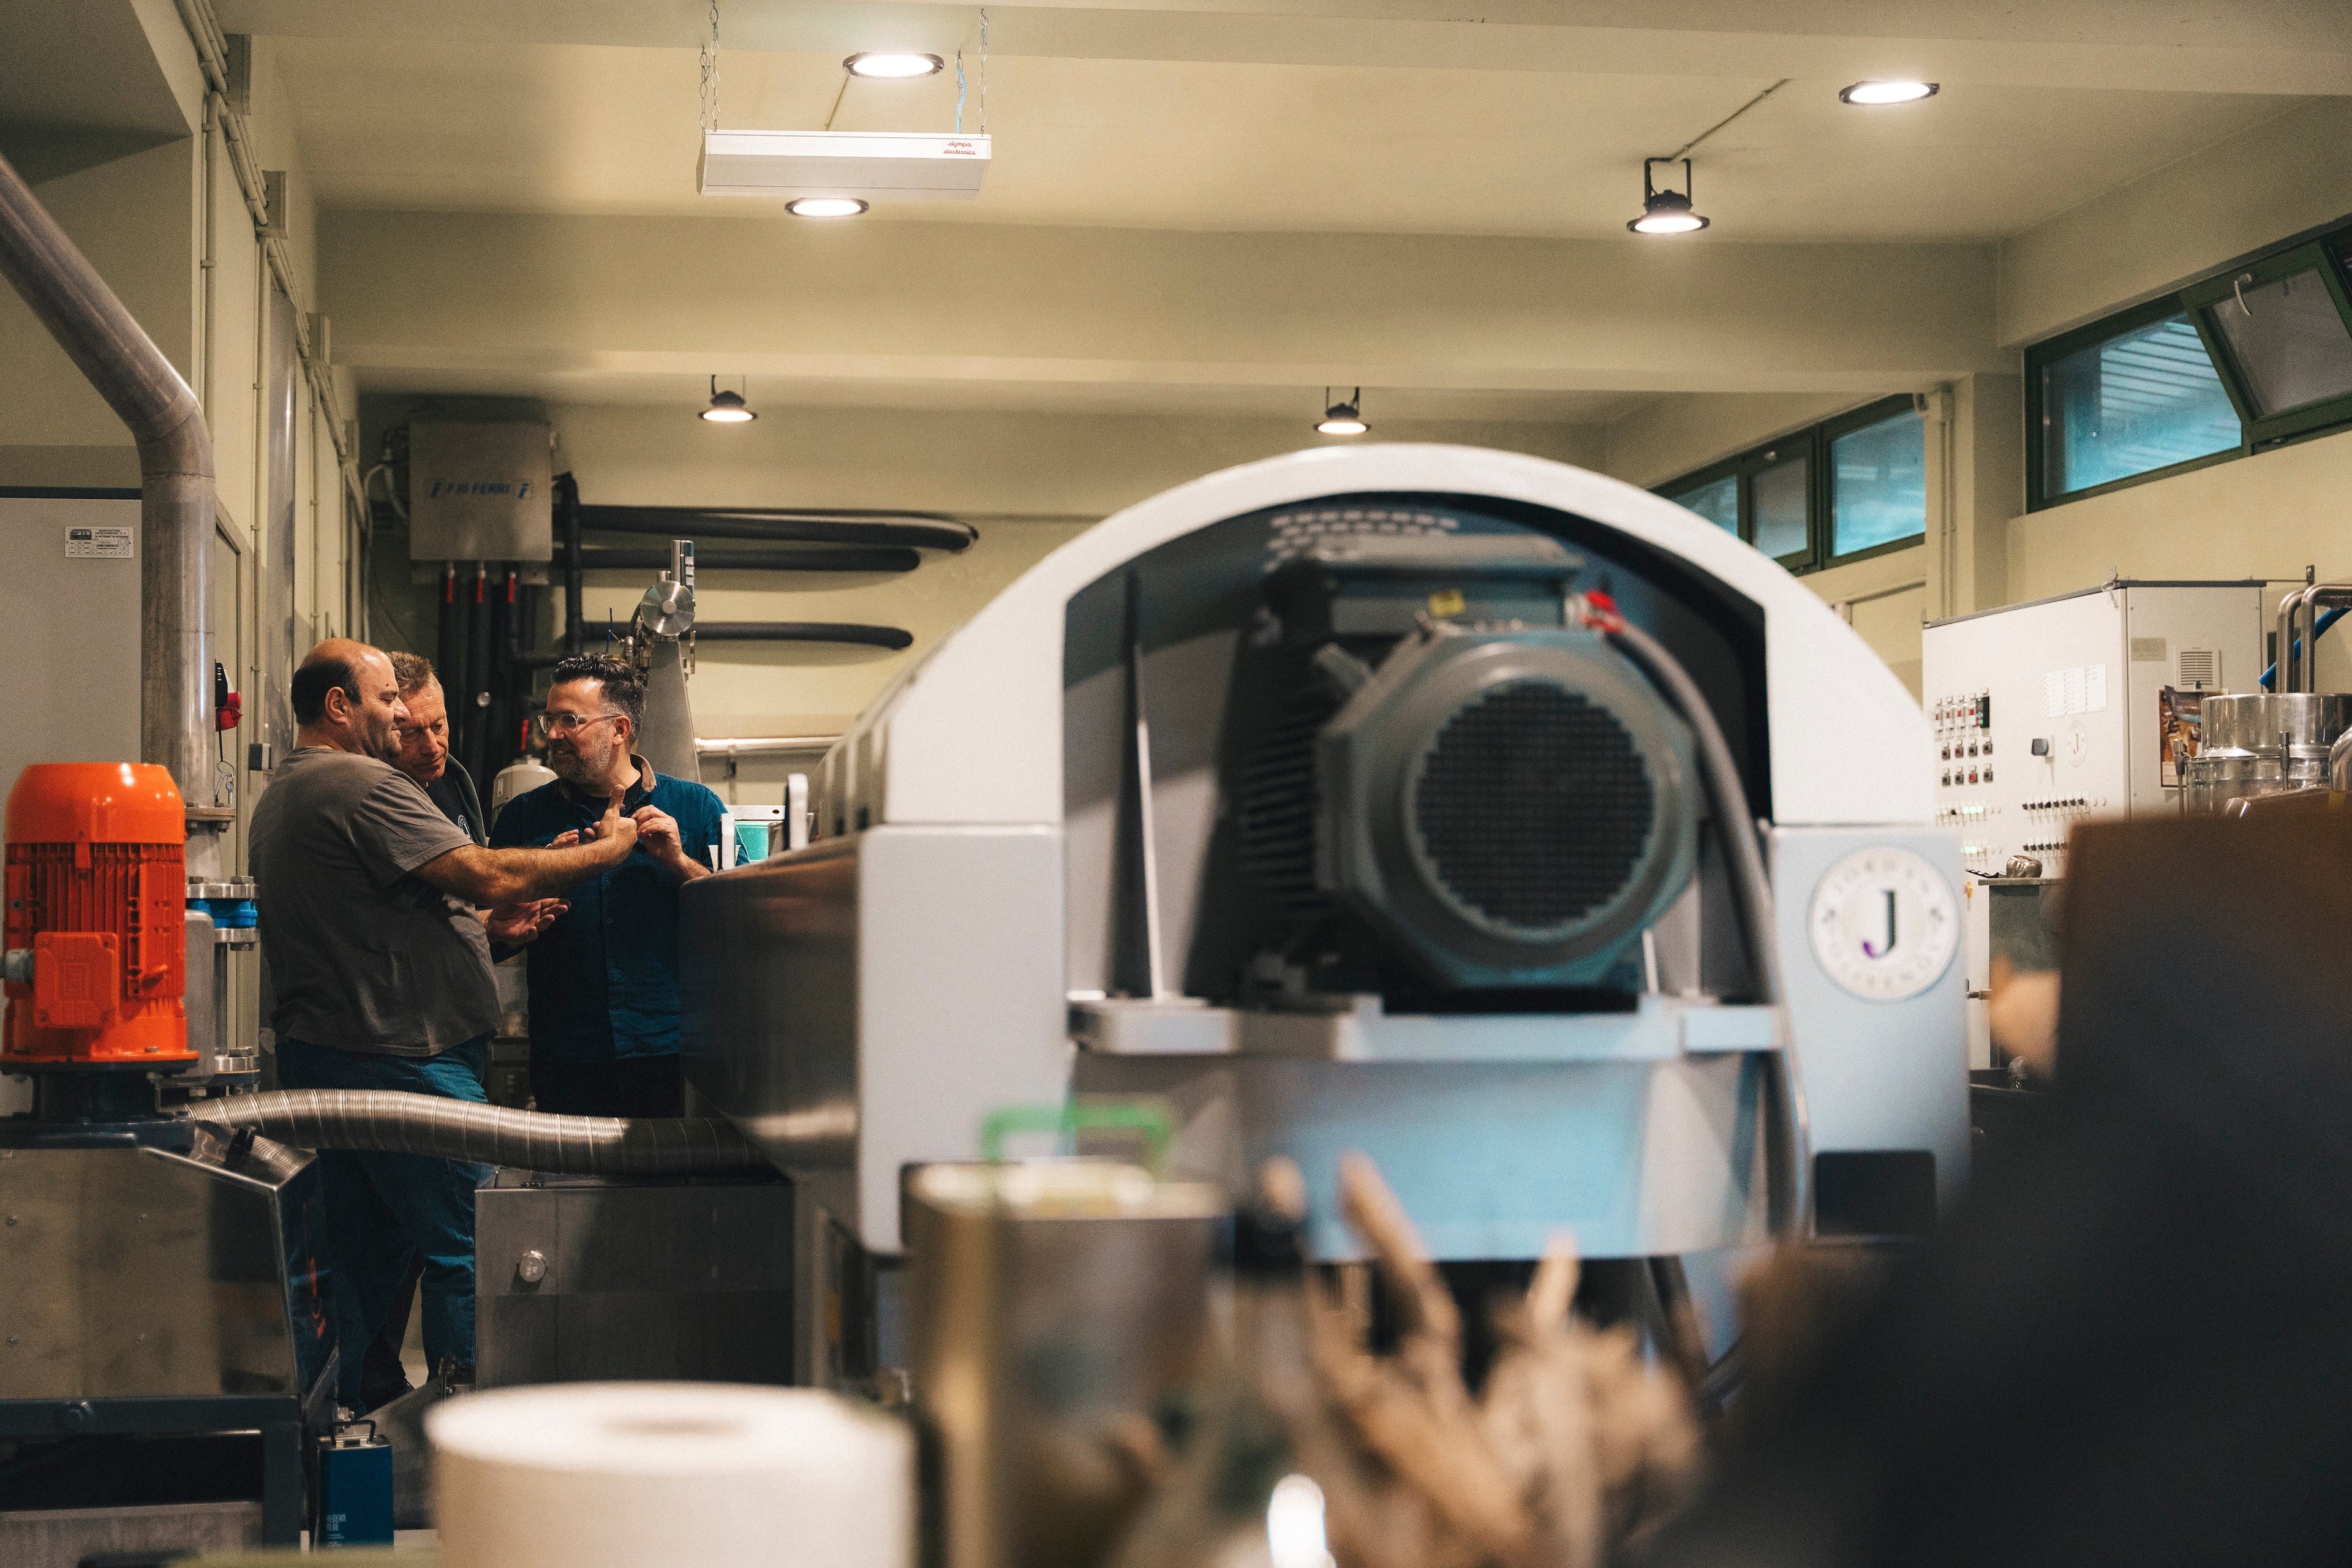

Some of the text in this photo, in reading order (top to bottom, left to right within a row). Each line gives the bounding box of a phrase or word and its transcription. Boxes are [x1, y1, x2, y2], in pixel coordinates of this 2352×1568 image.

[1861, 888, 1898, 960] J
[326, 1514, 346, 1523] AEGEAN
[326, 1523, 339, 1531] BLUE
